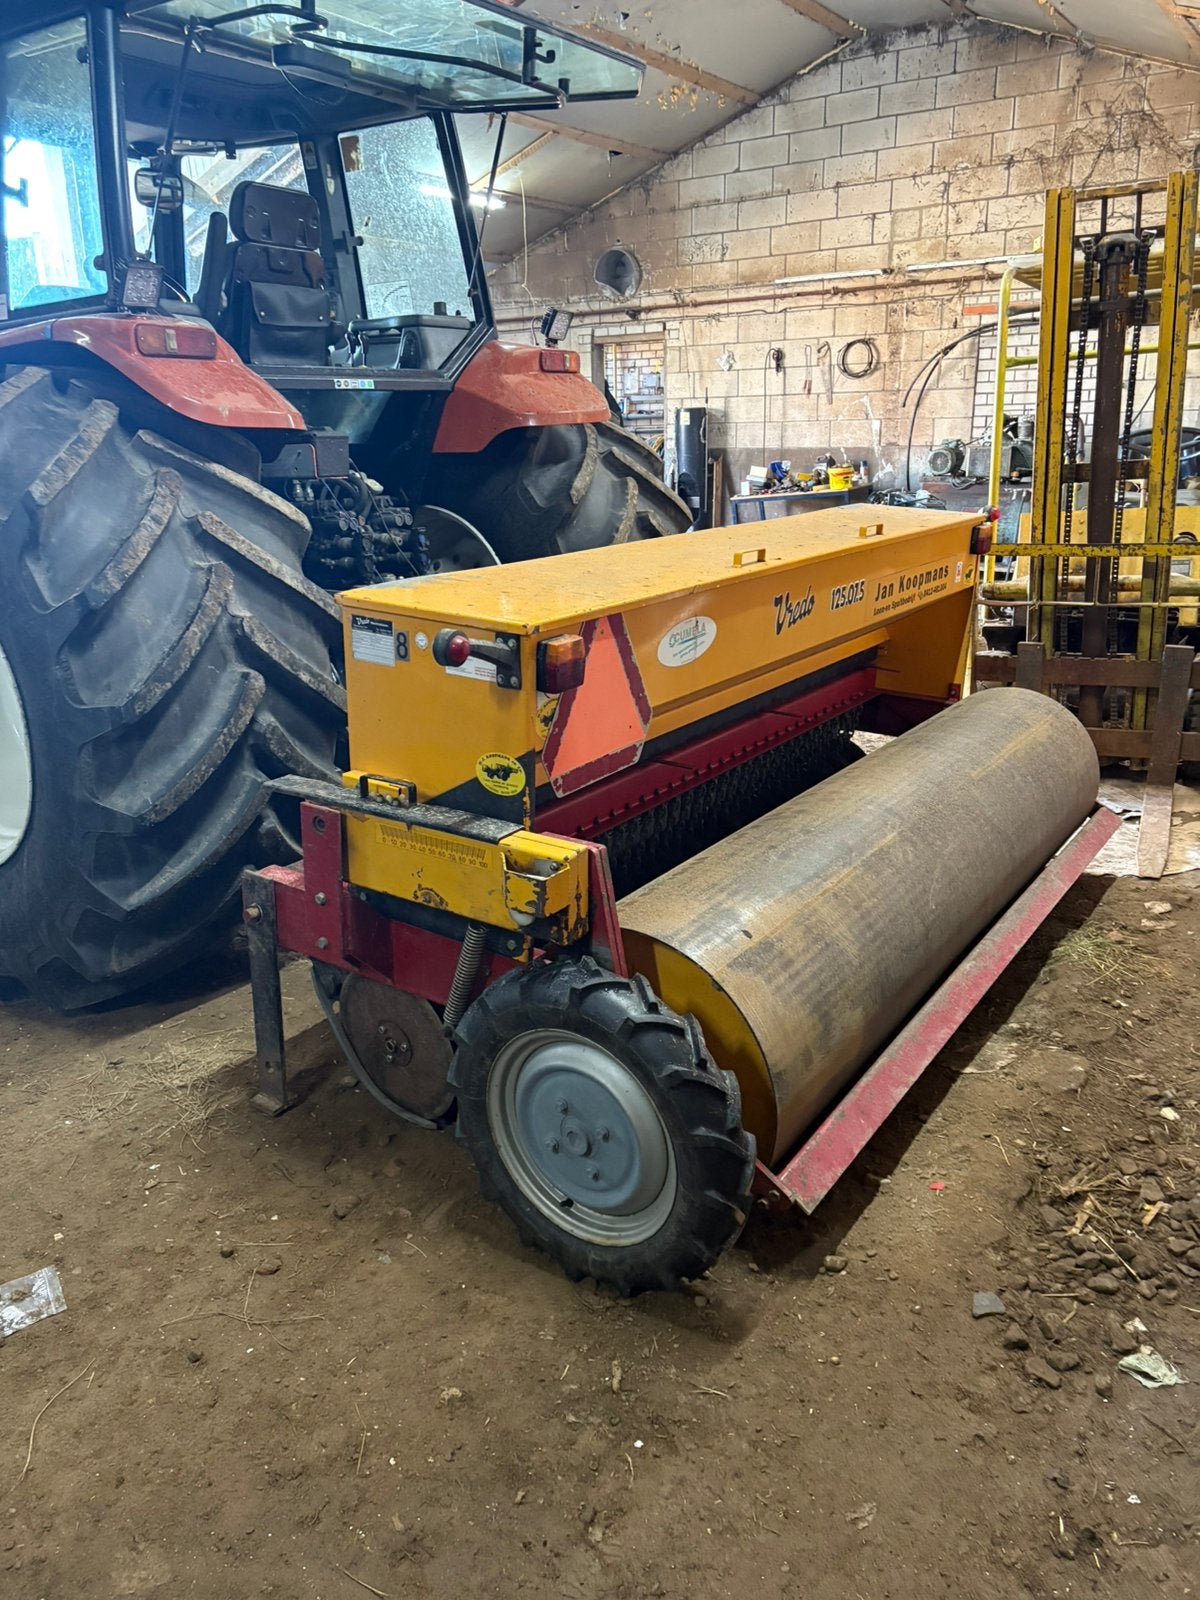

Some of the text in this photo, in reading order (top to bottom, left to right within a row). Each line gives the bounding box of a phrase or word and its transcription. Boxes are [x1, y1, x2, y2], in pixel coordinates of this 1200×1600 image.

[874, 583, 895, 602] Jan
[898, 565, 949, 594] Koopmans
[774, 584, 815, 635] Vredo
[396, 631, 409, 660] 8
[478, 861, 489, 869] 100
